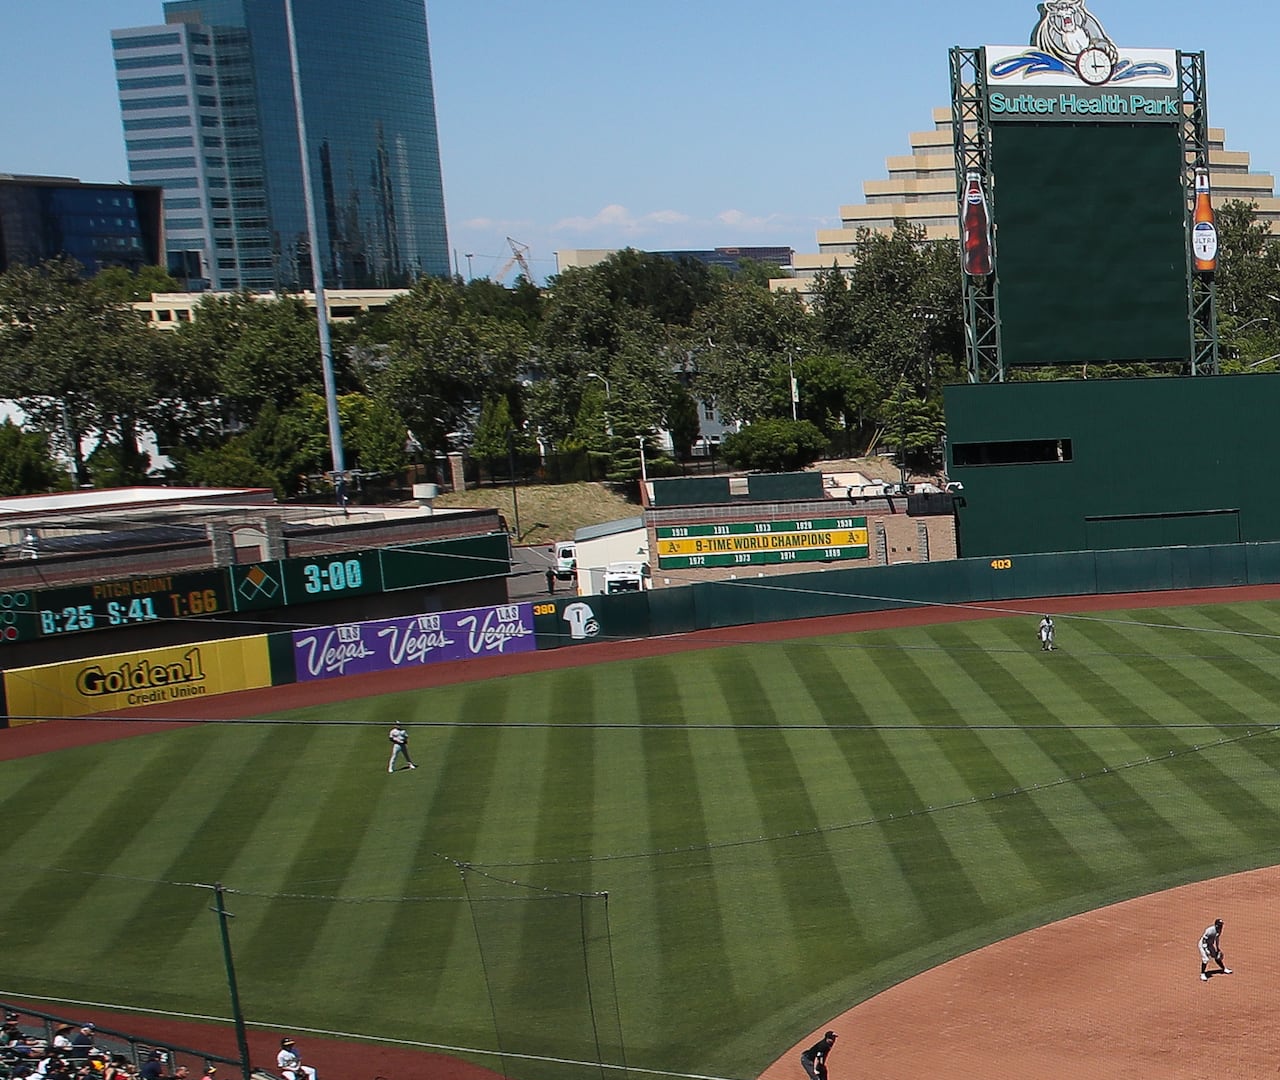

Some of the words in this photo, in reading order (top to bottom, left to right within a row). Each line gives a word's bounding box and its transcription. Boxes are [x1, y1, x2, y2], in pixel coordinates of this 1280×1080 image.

[990, 92, 1056, 114] Sutter
[1060, 94, 1128, 115] Health
[1130, 95, 1179, 116] Park
[734, 535, 768, 549] WORLD
[771, 533, 831, 547] CHAMPIONS
[991, 559, 1011, 570] 403
[304, 559, 363, 594] 3:00
[93, 581, 130, 599] PITCH
[133, 577, 173, 594] COUNT
[40, 605, 95, 634] B:25
[108, 598, 157, 625] S:41
[170, 589, 216, 616] T:66
[497, 605, 519, 622] LAS
[534, 604, 555, 615] 380
[339, 625, 359, 641] LAS
[418, 615, 440, 631] LAS
[457, 612, 532, 653] Vegas
[377, 620, 454, 665] Vegas
[296, 632, 375, 676] Vegas
[127, 690, 166, 705] Credit
[170, 684, 206, 698] Union
